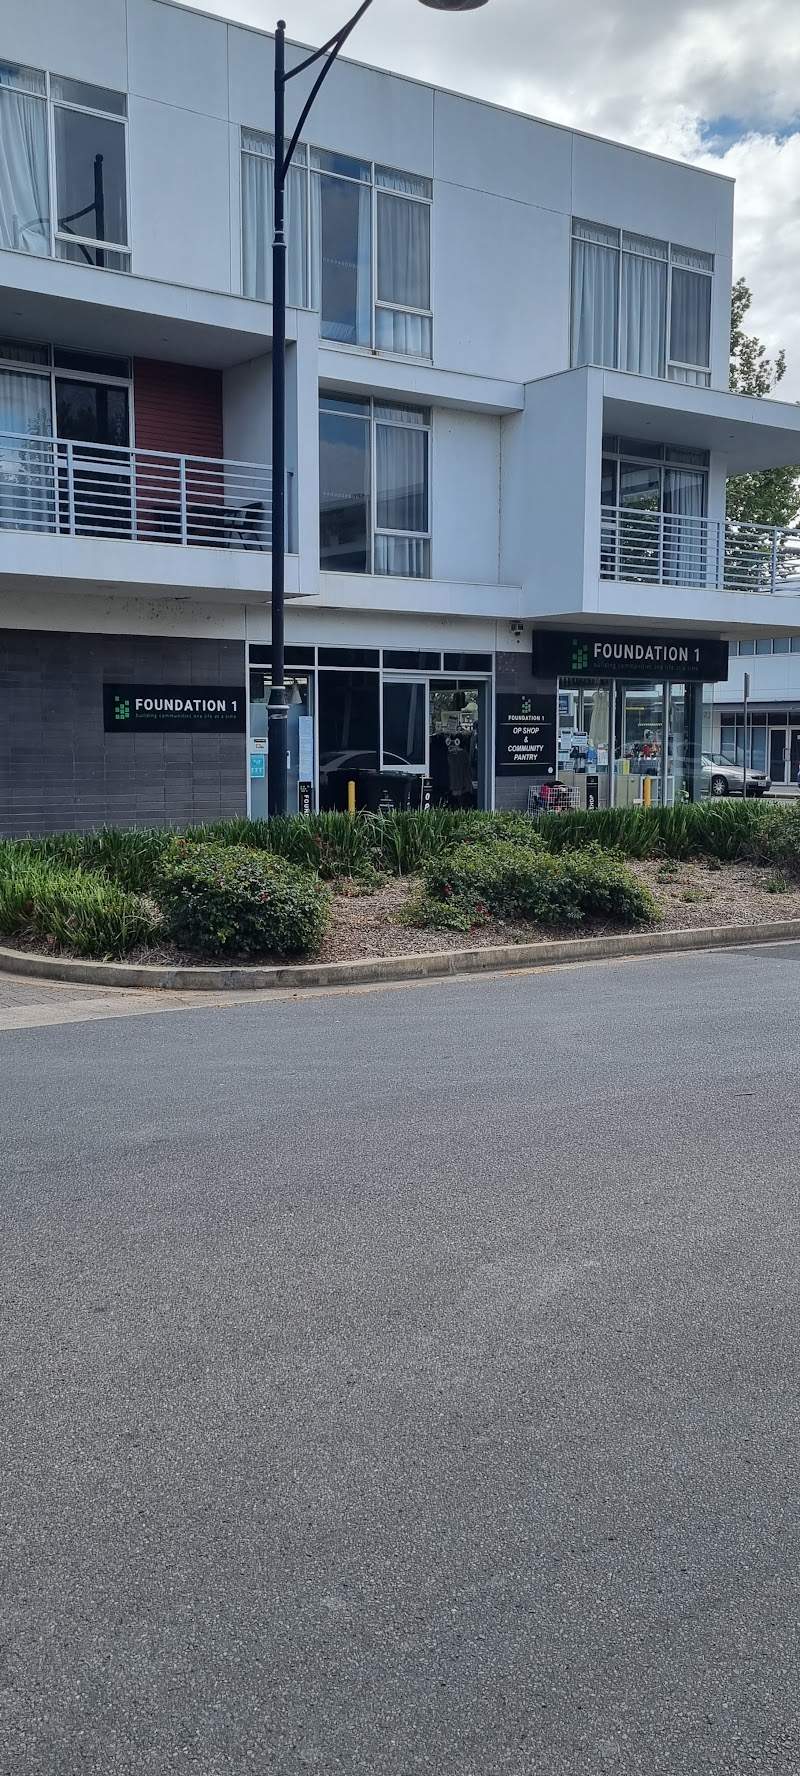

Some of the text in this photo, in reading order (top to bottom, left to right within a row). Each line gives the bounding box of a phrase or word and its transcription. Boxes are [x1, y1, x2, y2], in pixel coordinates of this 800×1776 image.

[594, 643, 700, 662] FOUNDATION 1
[135, 699, 237, 712] FOUNDATION 1
[523, 735, 529, 743] &
